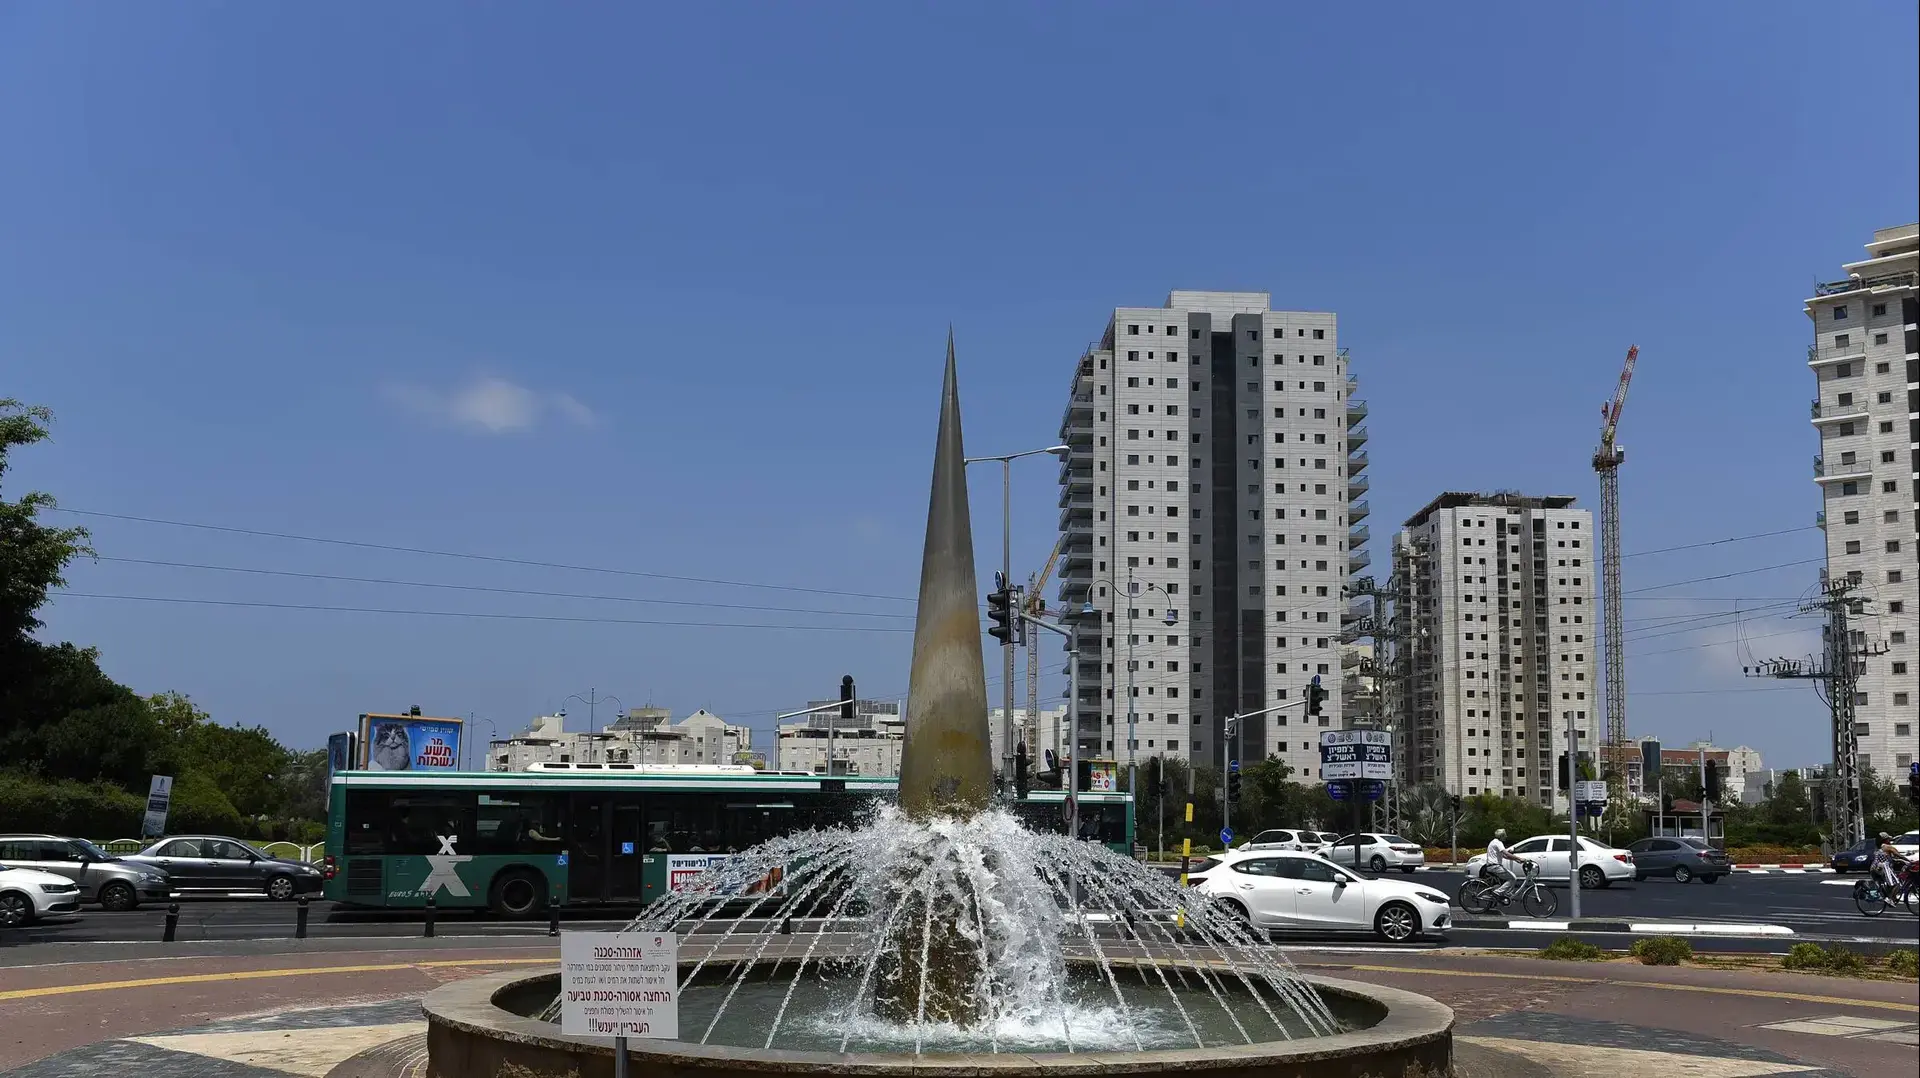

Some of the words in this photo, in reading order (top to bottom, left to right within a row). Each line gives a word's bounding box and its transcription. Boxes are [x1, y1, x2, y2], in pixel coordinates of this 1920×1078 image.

[431, 737, 443, 746] מר
[424, 745, 452, 757] תשע
[416, 756, 455, 768] נשמות
[671, 859, 707, 868] ללימודים?
[620, 976, 628, 985] את
[658, 974, 665, 985] חל
[567, 990, 591, 1002] טביעה
[643, 991, 671, 1002] הרחצה
[646, 1006, 654, 1016] חל
[588, 1018, 618, 1033] ייענש!!!
[621, 1021, 650, 1036] העבריין
